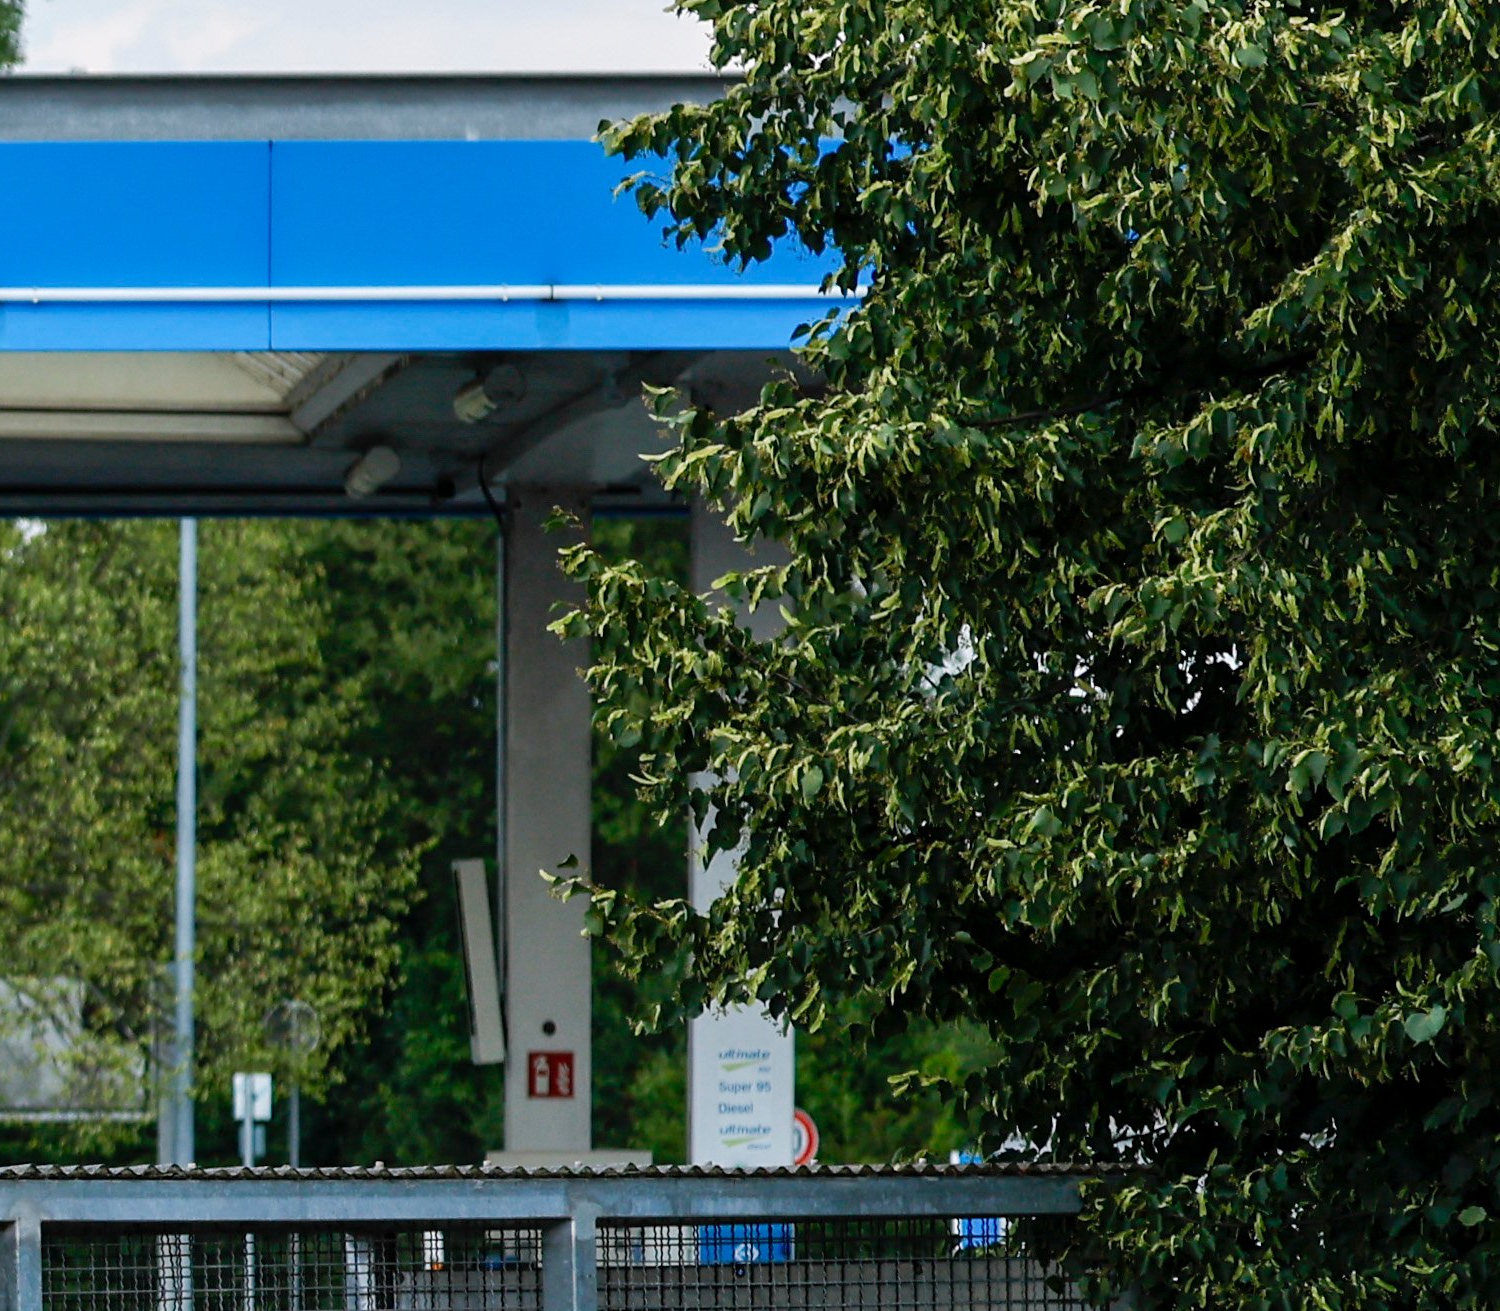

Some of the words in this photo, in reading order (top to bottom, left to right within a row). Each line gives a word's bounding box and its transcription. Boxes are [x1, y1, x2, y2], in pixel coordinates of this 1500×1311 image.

[719, 1081, 752, 1094] Super
[756, 1081, 771, 1092] 95
[719, 1103, 753, 1114] Diesel
